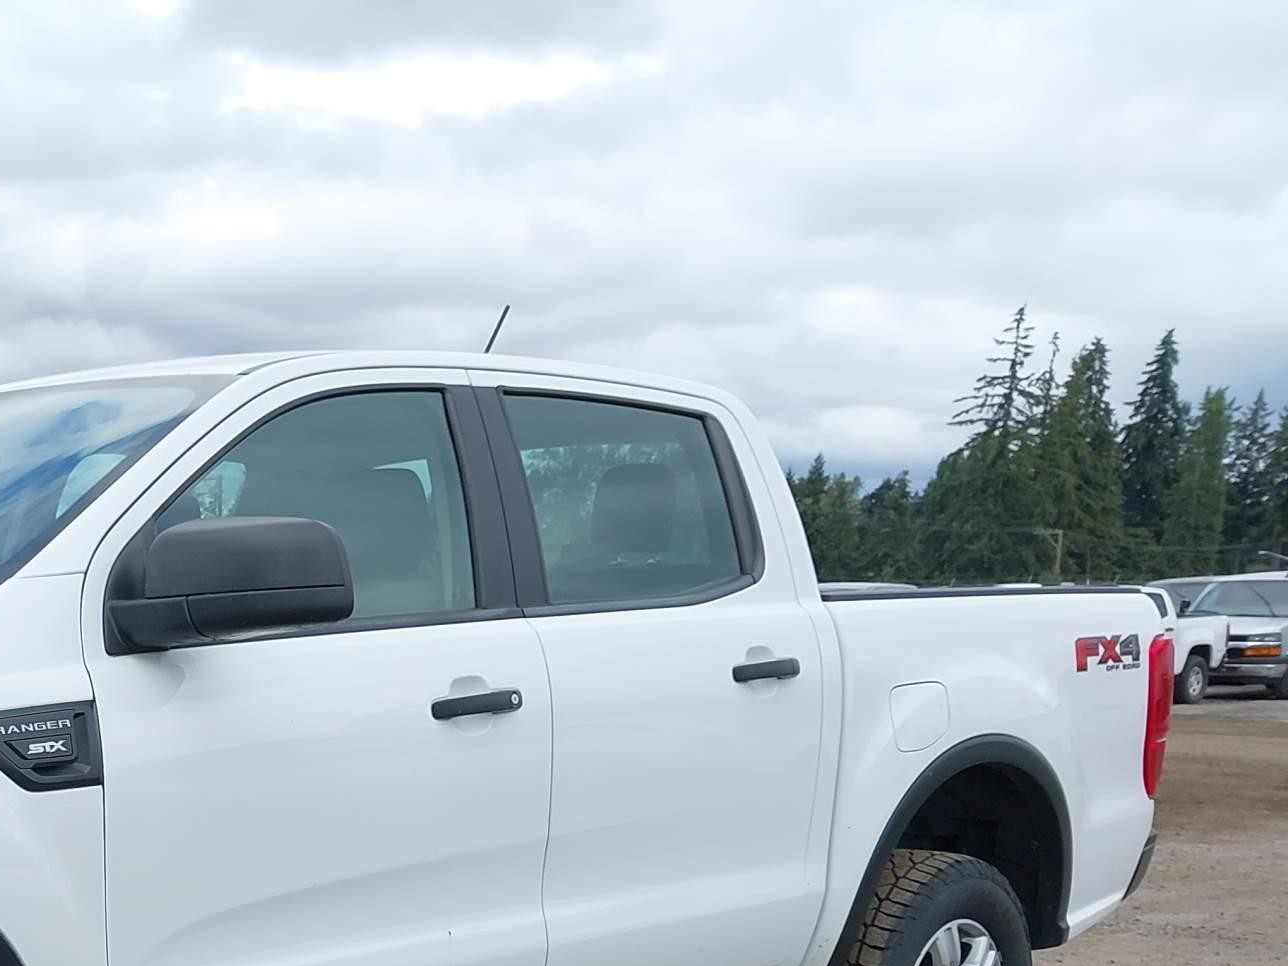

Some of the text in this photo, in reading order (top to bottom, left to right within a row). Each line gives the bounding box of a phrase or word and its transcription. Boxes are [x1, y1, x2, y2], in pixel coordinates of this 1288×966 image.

[1075, 633, 1141, 672] FX4
[1105, 663, 1120, 672] OFF
[27, 739, 68, 755] STX
